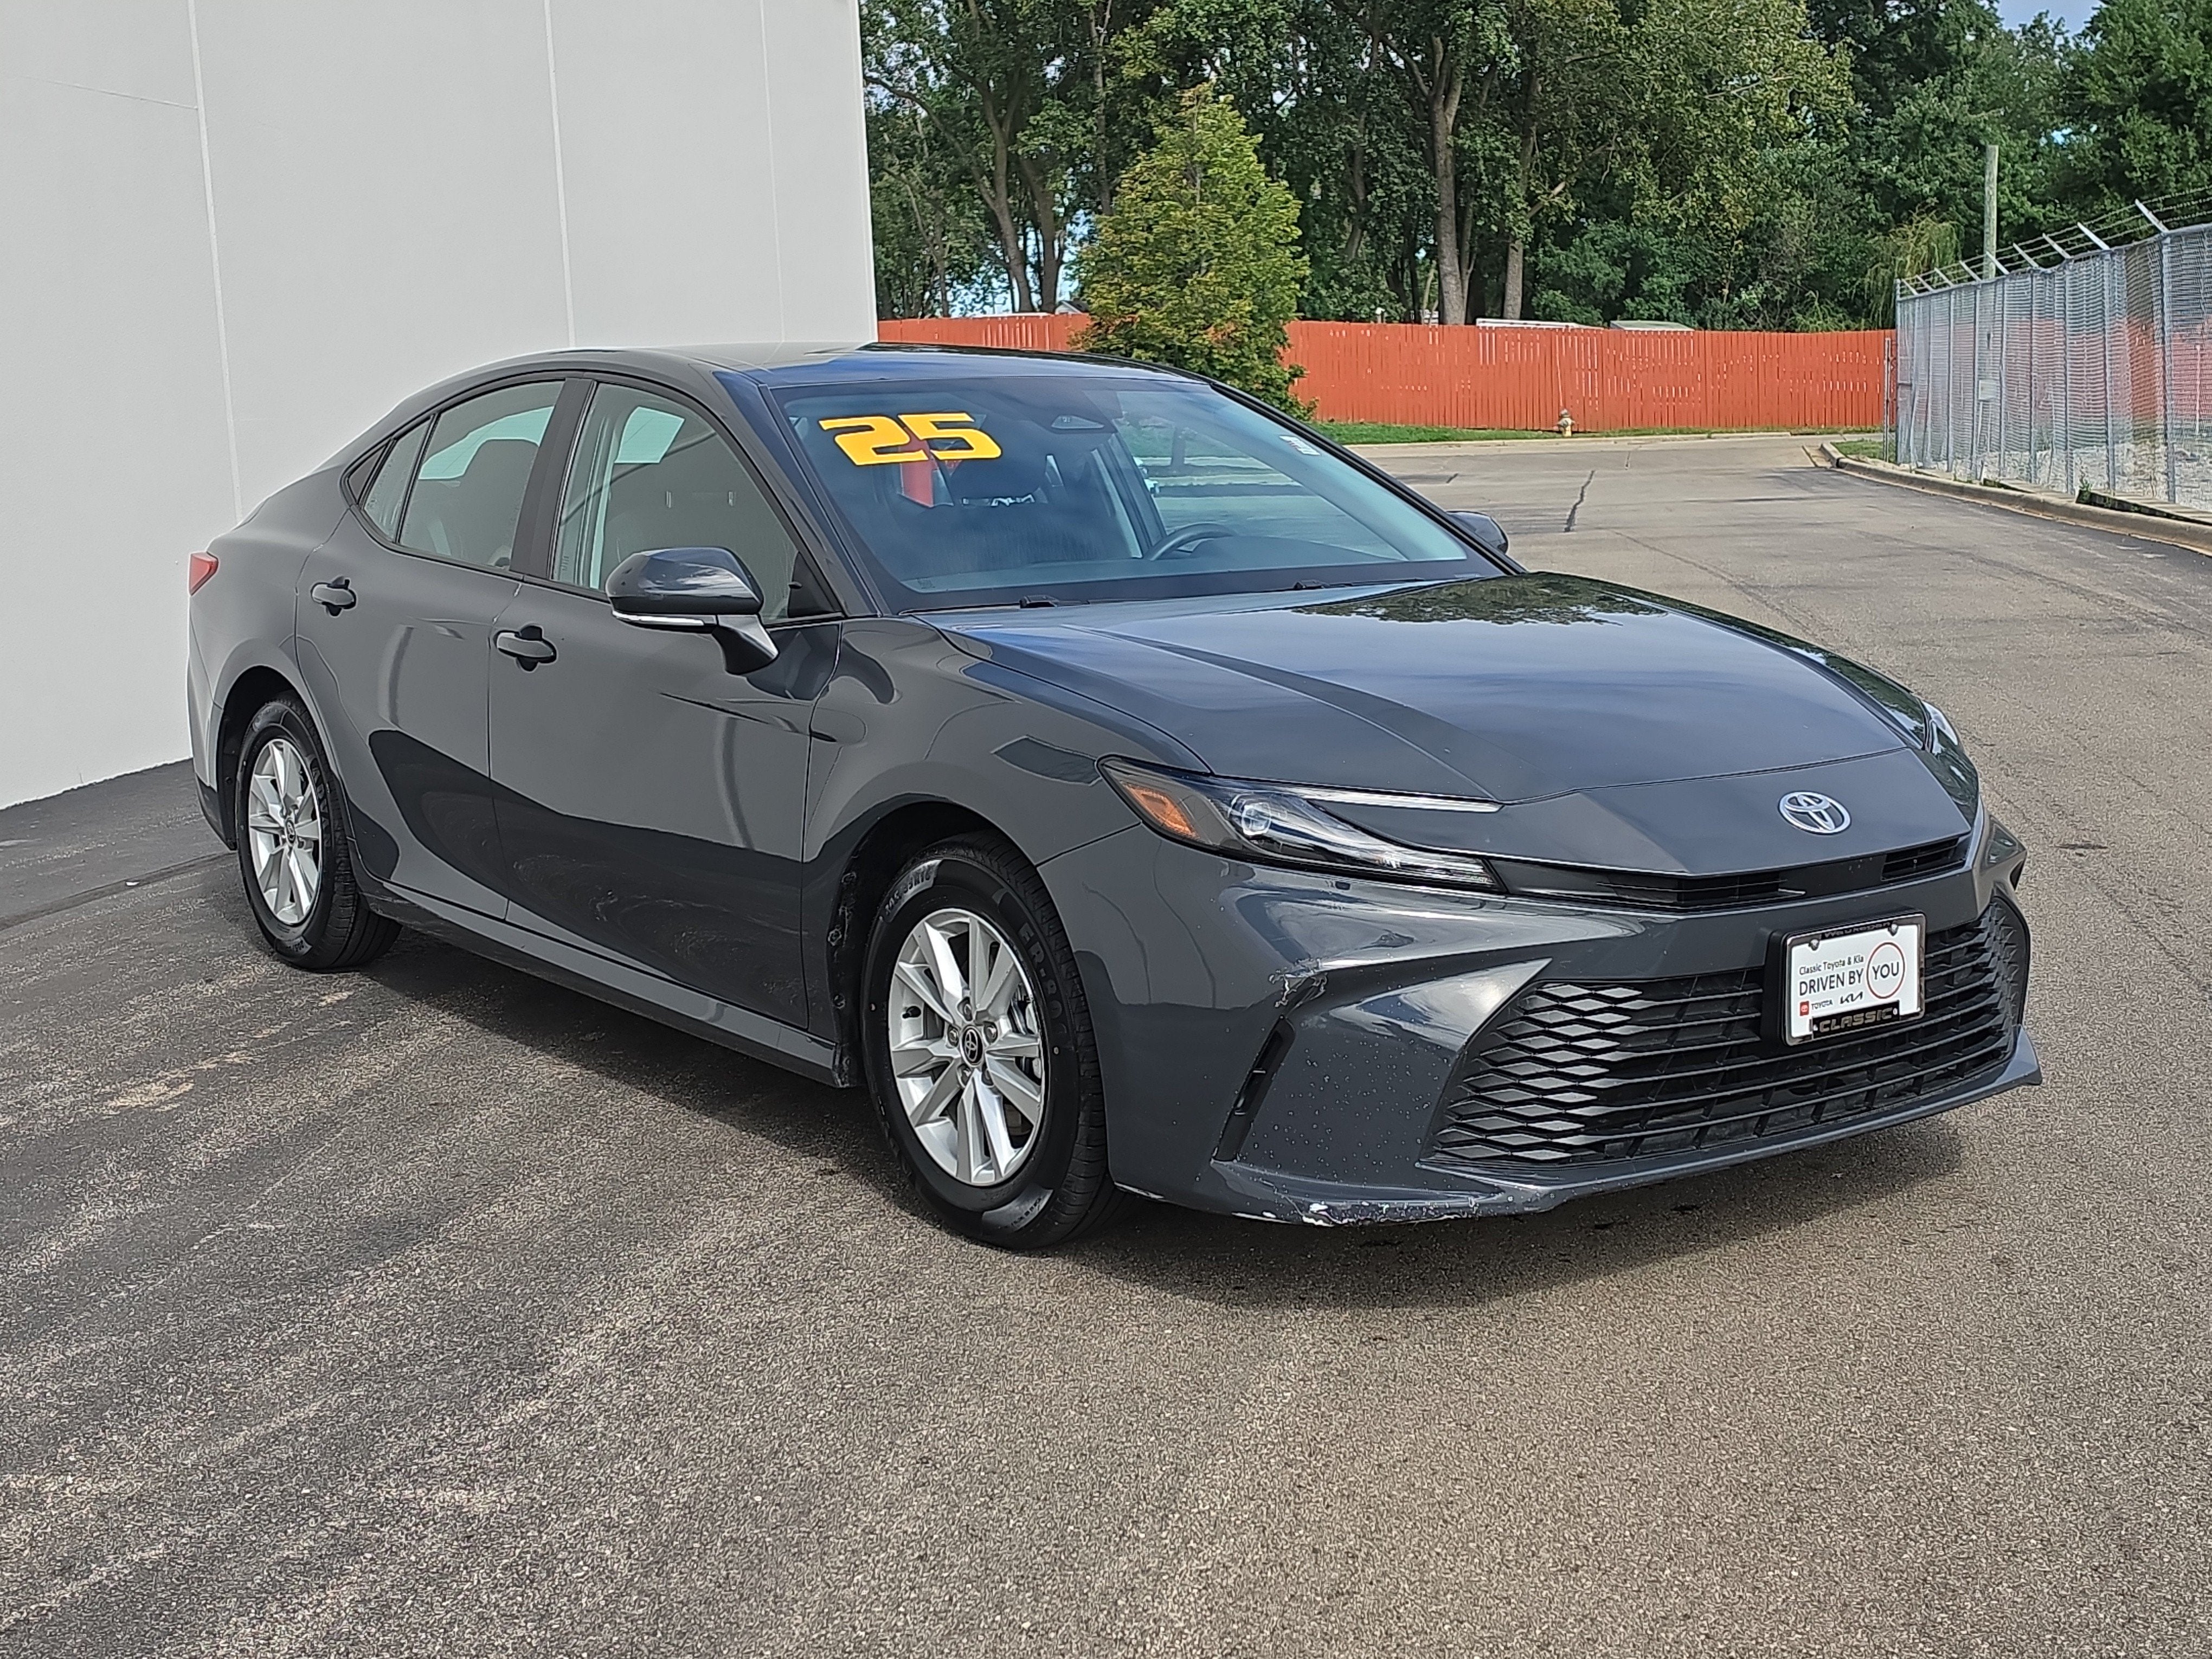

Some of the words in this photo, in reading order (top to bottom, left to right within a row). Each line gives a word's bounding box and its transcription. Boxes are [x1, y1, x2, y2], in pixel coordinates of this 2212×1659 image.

[819, 412, 1002, 466] 25
[1799, 963, 1822, 975] Classic
[1823, 960, 1846, 971] Toyota
[1847, 956, 1851, 965] &
[1853, 955, 1864, 963] Kia
[1799, 972, 1845, 996] DRIVEN
[1849, 968, 1864, 985] BY
[1872, 961, 1899, 980] YOU
[1811, 999, 1833, 1010] TOYOTA
[1819, 1007, 1893, 1033] CLASSIC
